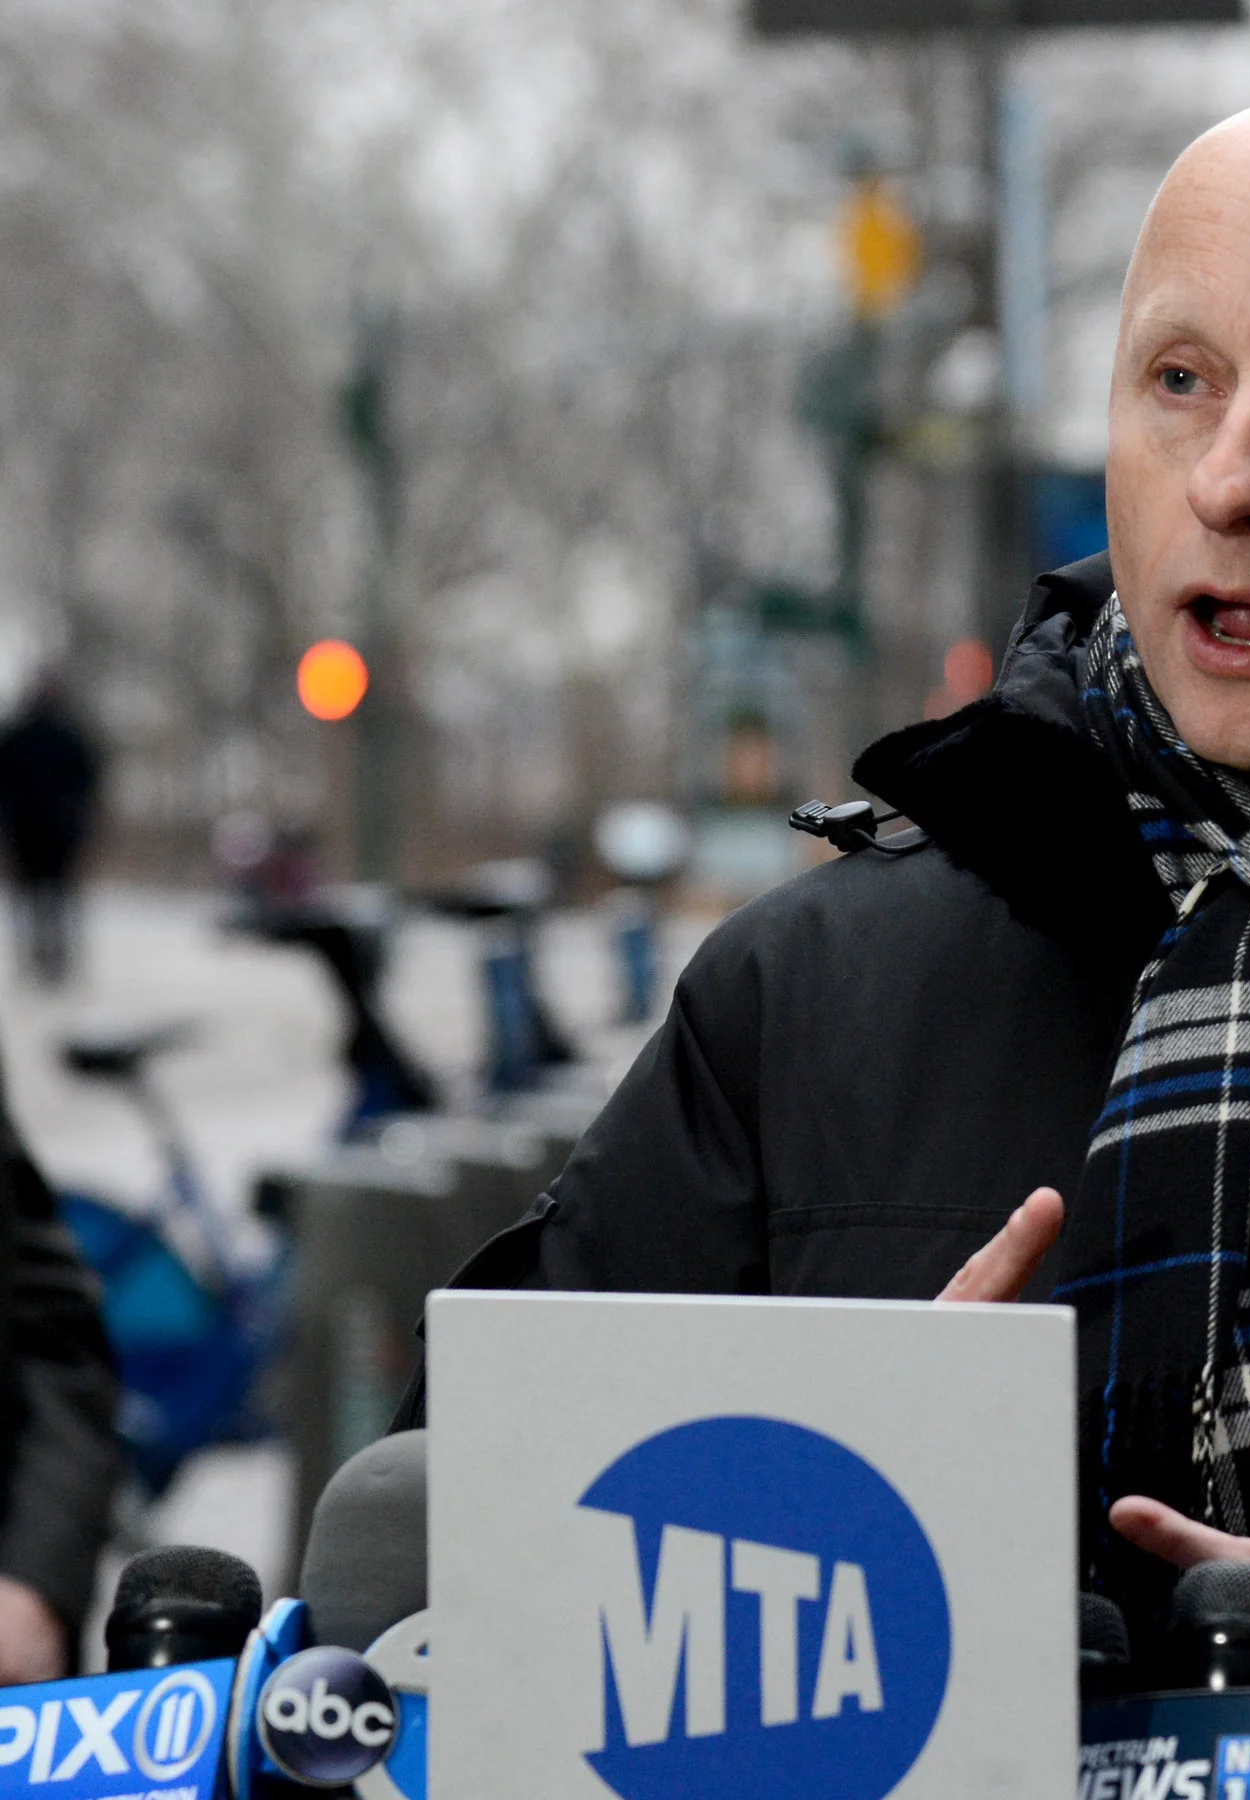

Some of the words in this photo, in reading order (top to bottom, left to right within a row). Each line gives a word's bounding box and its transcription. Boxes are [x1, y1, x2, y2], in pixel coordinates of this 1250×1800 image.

[577, 1502, 884, 1753] MTA
[0, 1690, 143, 1785] PIX
[153, 1692, 196, 1762] 11
[263, 1678, 394, 1747] abc
[1079, 1736, 1179, 1767] PECTRUM
